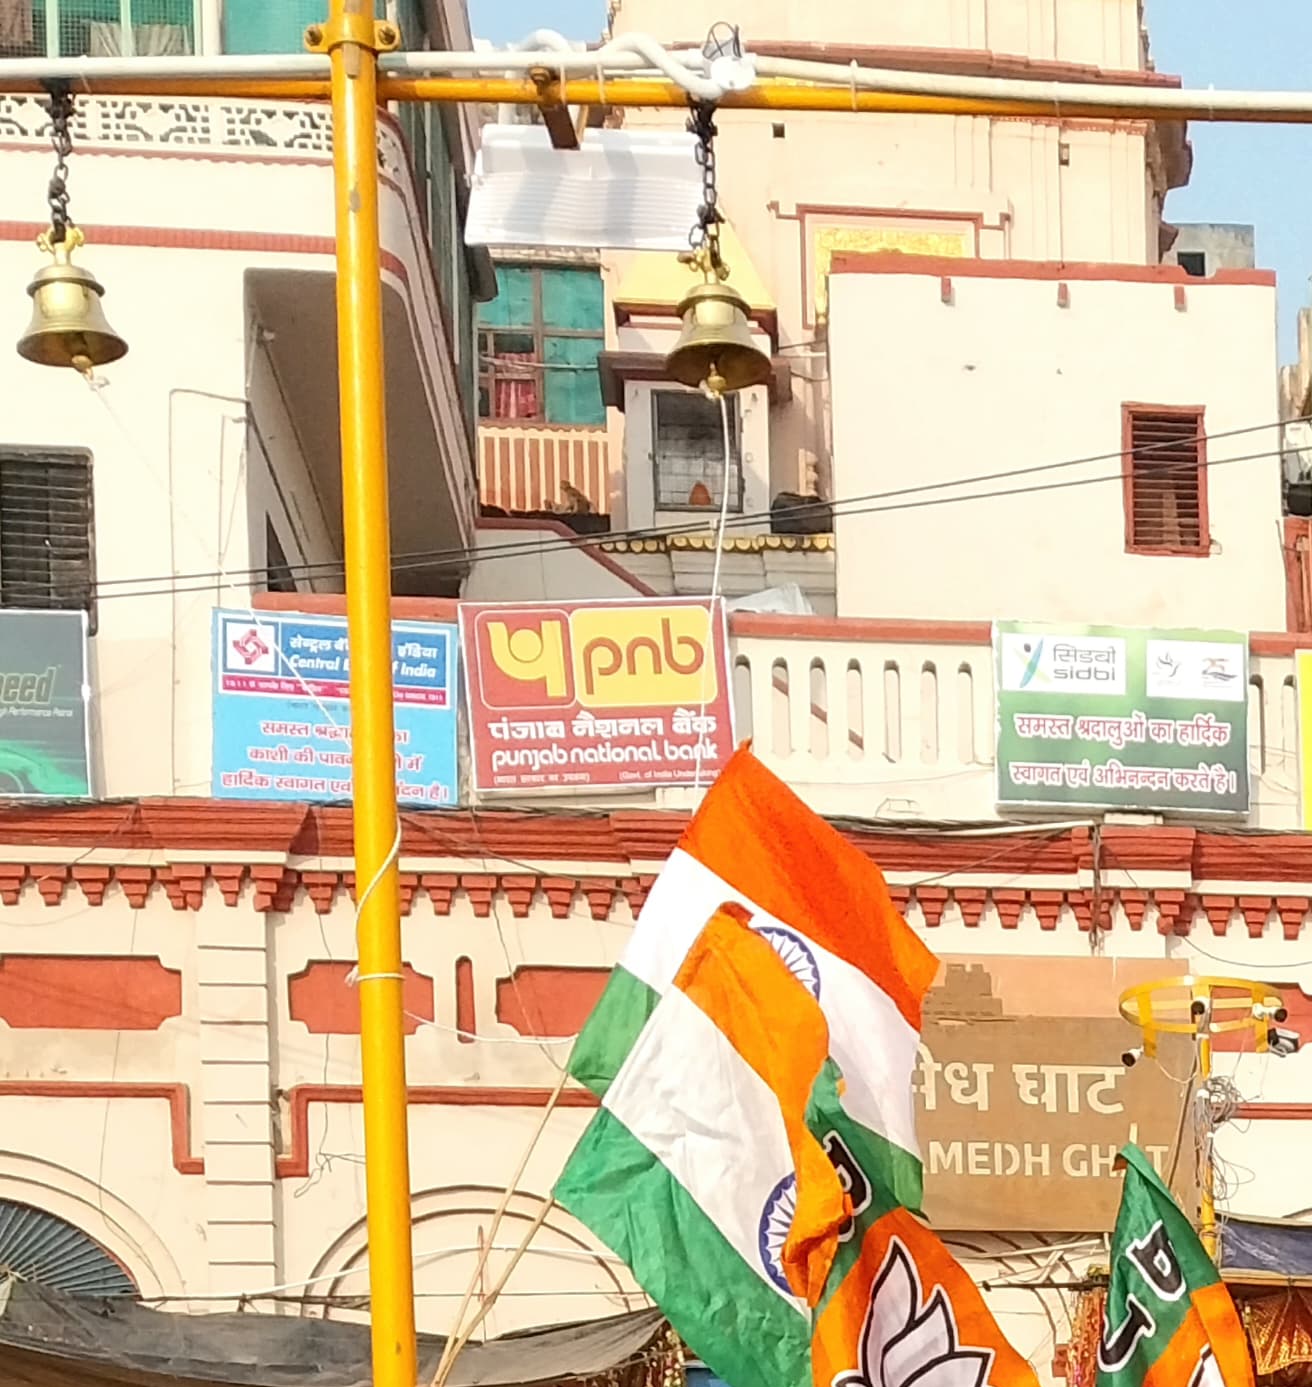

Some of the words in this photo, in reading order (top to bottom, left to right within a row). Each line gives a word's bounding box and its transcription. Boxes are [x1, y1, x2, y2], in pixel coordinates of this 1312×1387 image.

[289, 655, 340, 672] Central
[583, 618, 704, 695] pnb
[400, 665, 437, 678] India
[1053, 667, 1116, 682] sidbi
[261, 721, 309, 736] समस्त
[314, 724, 351, 743] श्रद्धा
[487, 717, 565, 741] पंजाब
[671, 708, 718, 735] बैंक
[1016, 715, 1072, 737] समस्त
[1150, 721, 1172, 742] का
[1178, 716, 1229, 744] हार्दिक
[249, 746, 289, 762] काशी
[294, 746, 314, 763] की
[491, 743, 568, 772] punjab
[570, 739, 661, 768] national
[663, 737, 718, 762] bank
[276, 776, 326, 791] स्वागत
[1011, 763, 1061, 782] स्वागत
[1012, 1063, 1126, 1114] घाट
[922, 1141, 1049, 1176] MEDH
[1062, 1144, 1169, 1178] GHT
